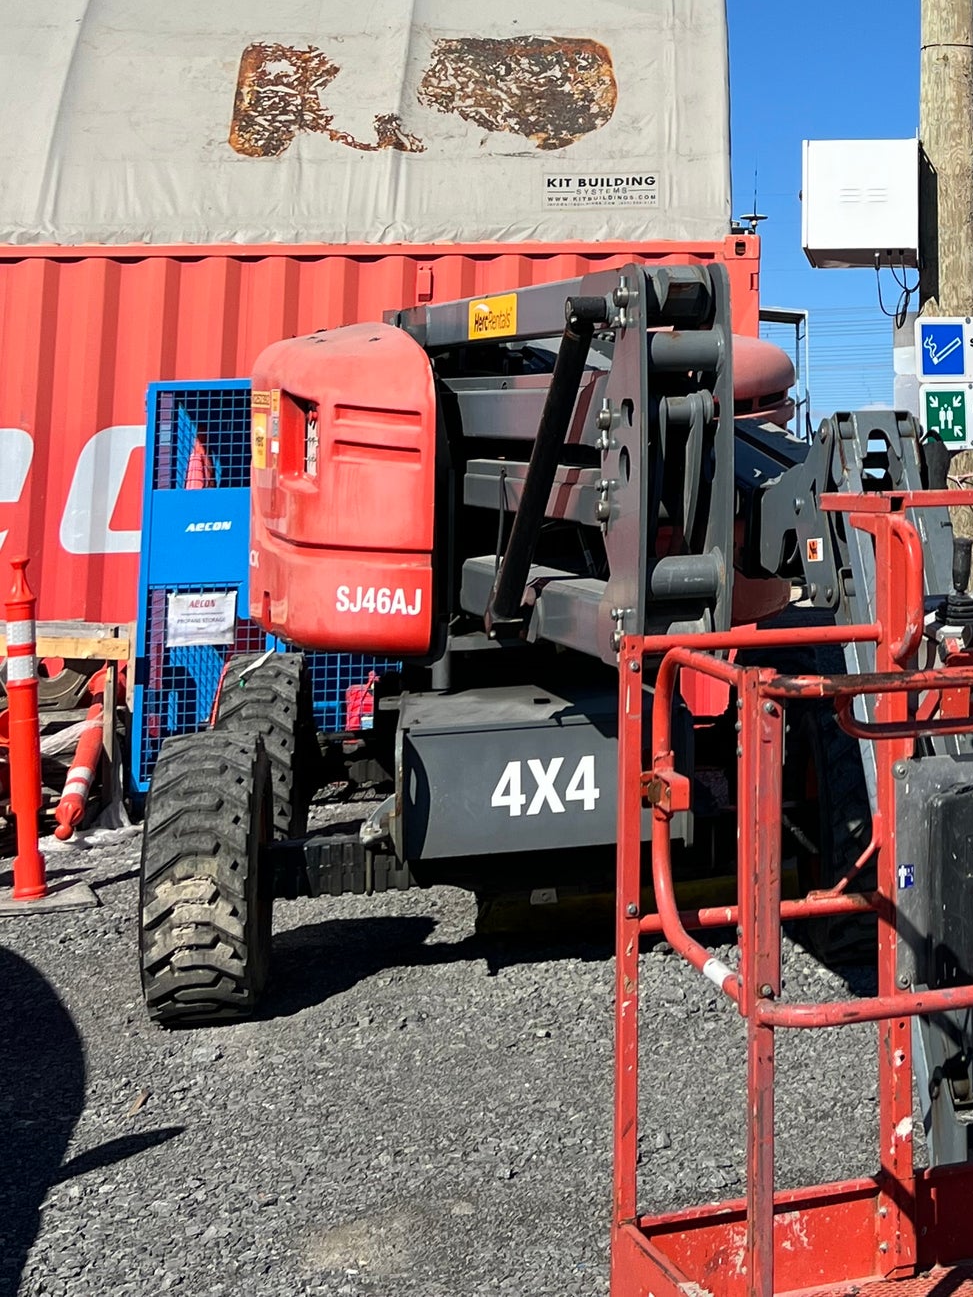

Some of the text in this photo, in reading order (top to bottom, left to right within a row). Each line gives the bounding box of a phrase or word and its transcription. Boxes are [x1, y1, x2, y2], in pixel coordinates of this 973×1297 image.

[547, 176, 656, 187] KIT BUILDING
[576, 187, 627, 195] SYSTEMS
[335, 585, 422, 615] SJ46AJ
[491, 755, 600, 816] 4X4
